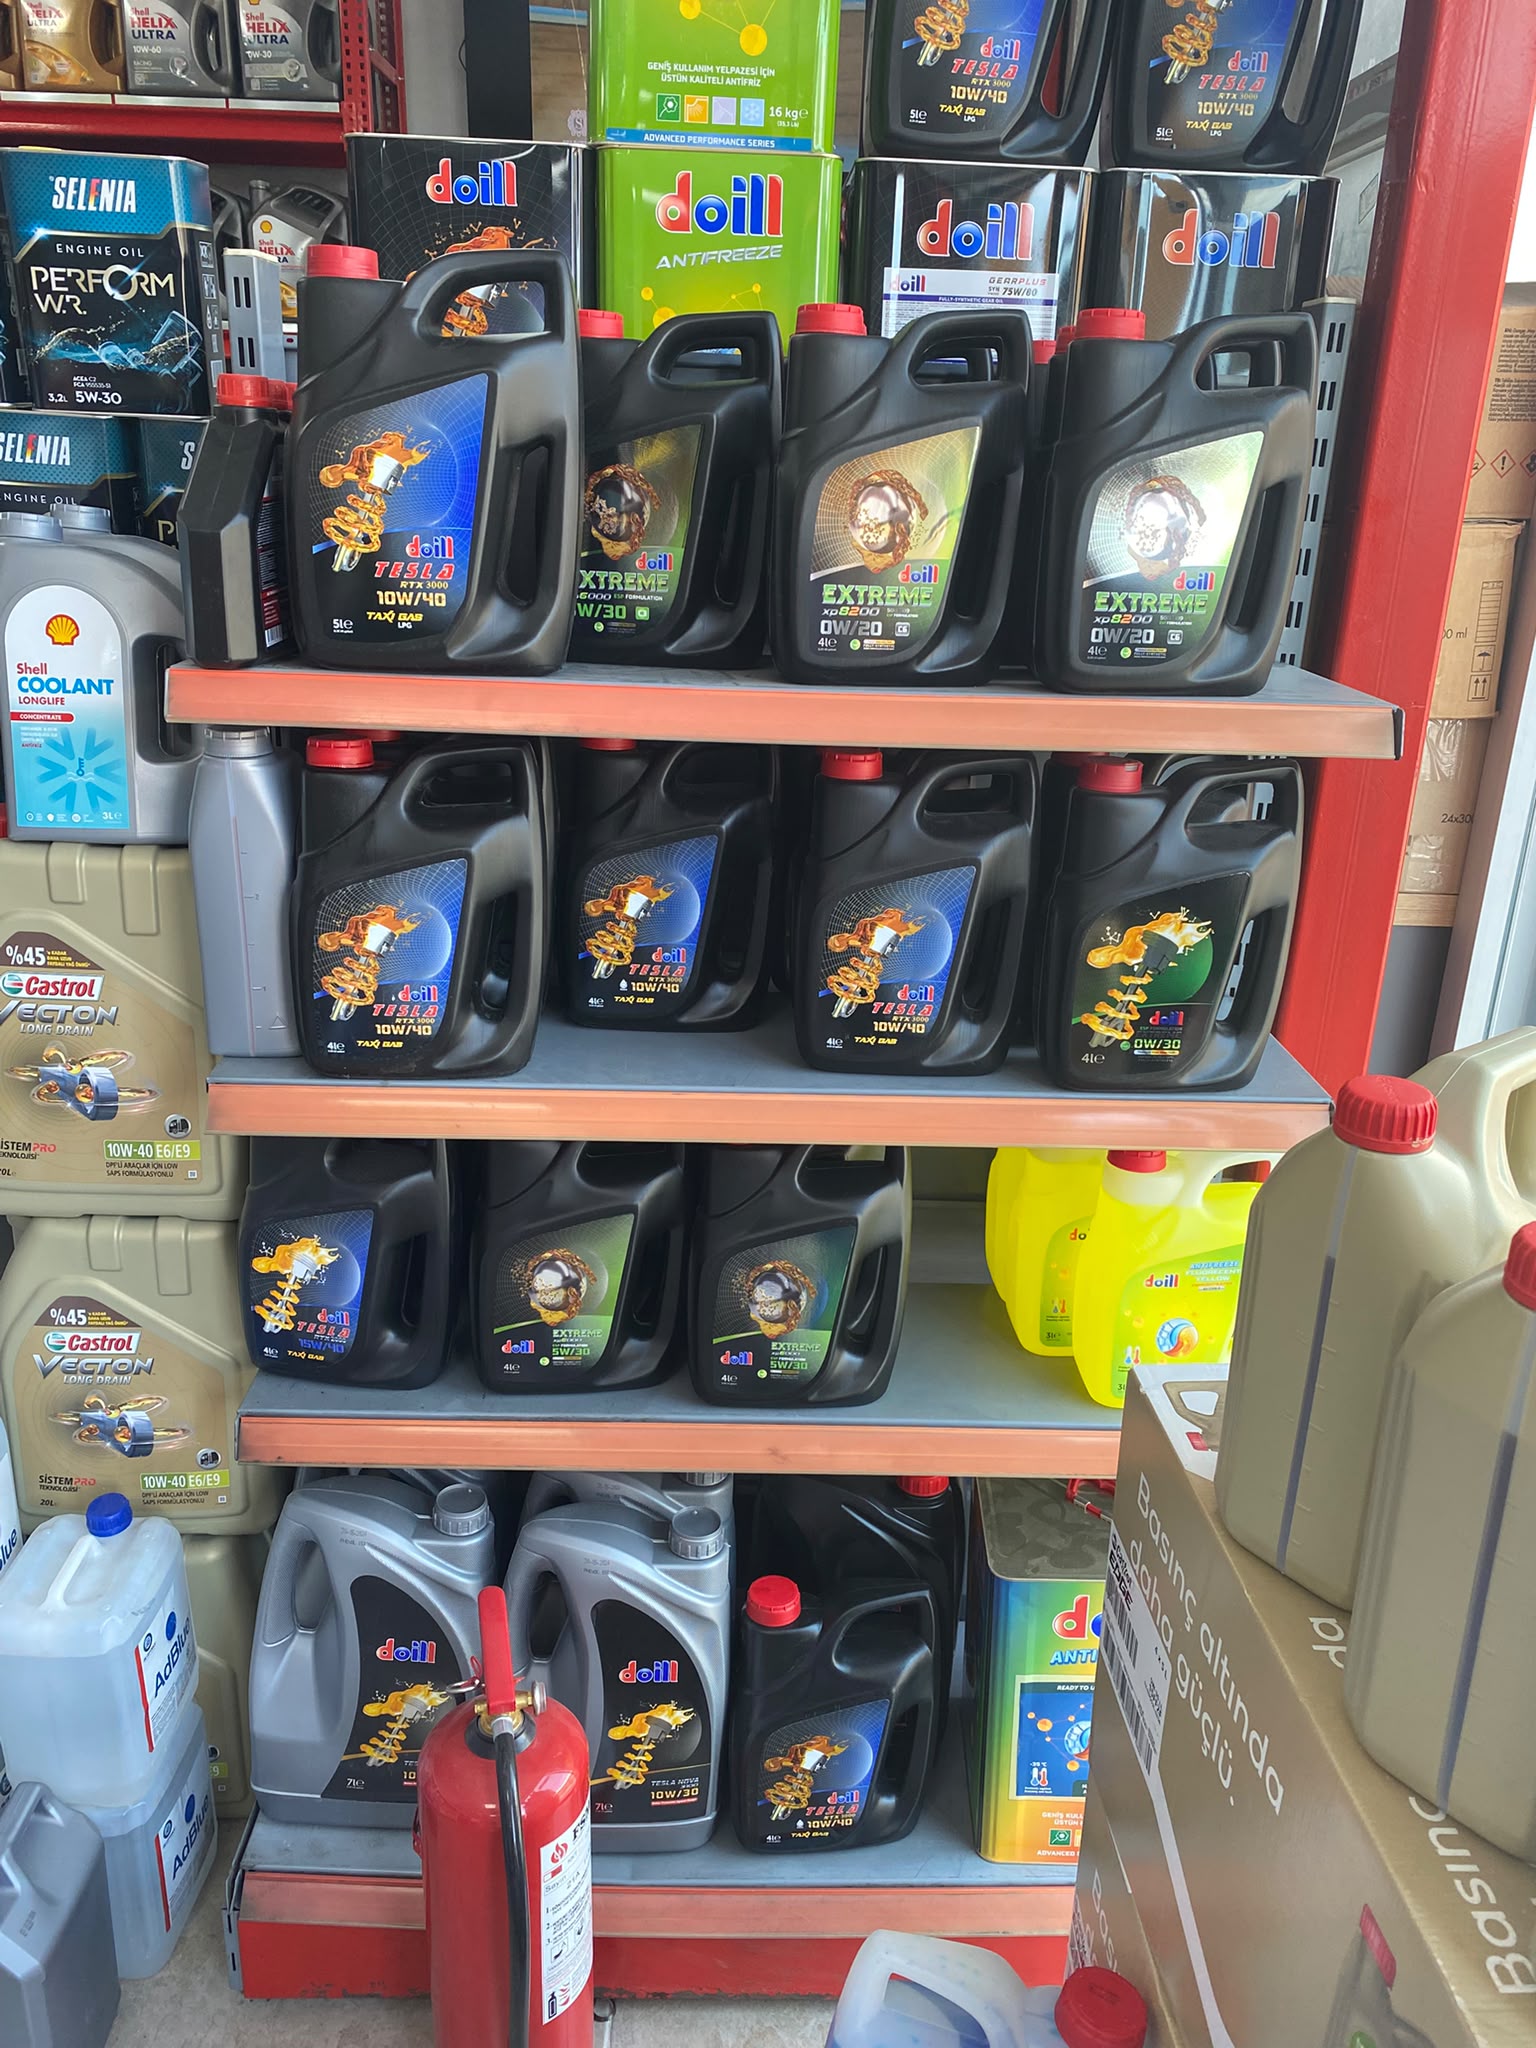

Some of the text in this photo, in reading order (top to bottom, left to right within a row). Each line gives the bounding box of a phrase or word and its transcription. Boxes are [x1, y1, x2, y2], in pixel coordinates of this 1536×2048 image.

[130, 15, 178, 29] HELIX
[245, 13, 265, 21] Shell
[246, 20, 291, 33] HELIX
[131, 30, 176, 40] ULTRA
[245, 34, 289, 44] ULTRA
[132, 45, 162, 54] 10W-60
[980, 36, 1021, 60] doill
[648, 61, 671, 72] GENİŞ
[673, 63, 713, 73] KULLANIM
[715, 65, 758, 75] YELPAZESİ
[951, 58, 1018, 80] TESLA
[1228, 50, 1268, 72] doill
[661, 73, 761, 87] ÜSTÜN KALİTELİ ANTİFRİZ
[1198, 74, 1266, 91] TESLA
[951, 85, 1007, 103] 10W/40
[769, 106, 781, 117] 16
[1198, 102, 1254, 116] 10W/40
[644, 133, 775, 148] ADVANCED PERFORMANCE SERIES
[425, 158, 518, 207] doill
[52, 176, 137, 213] SELENIA
[656, 170, 783, 238] doill
[916, 199, 1035, 261] doill
[1162, 208, 1281, 268] doill
[56, 243, 145, 258] ENGINE OIL
[656, 244, 783, 270] ANTIFREEZE
[30, 264, 175, 301] PERFORM
[989, 276, 1047, 286] GEARPLUS
[33, 294, 87, 315] W.R.
[75, 391, 122, 405] 5W-30
[406, 535, 454, 558] doill
[636, 552, 673, 571] doill
[374, 561, 455, 579] TESLA
[898, 564, 938, 584] doill
[425, 580, 448, 589] 3000
[575, 569, 669, 593] XTREME
[1173, 571, 1215, 591] doill
[376, 590, 446, 607] 10W/40
[822, 584, 934, 608] EXTREME
[1094, 591, 1208, 614] EXTREME
[367, 610, 395, 623] TAXI
[821, 607, 880, 618] xp8200
[1093, 614, 1153, 625] xp8200
[821, 620, 882, 637] 0W/20
[1091, 628, 1155, 644] 0W/20
[1455, 627, 1467, 639] ml
[17, 663, 47, 675] Shell
[17, 677, 114, 695] COOLANT
[18, 696, 65, 706] LONGLIFE
[19, 713, 62, 721] CONCENTRATE
[6, 946, 45, 966] %45
[652, 947, 686, 963] doill
[629, 964, 686, 976] TESLA
[25, 976, 95, 997] Castrol
[398, 985, 438, 1002] doill
[631, 982, 679, 993] 10W/40
[897, 984, 934, 1001] doill
[372, 1004, 438, 1017] TESLA
[872, 1002, 934, 1016] TESLA
[1149, 1010, 1184, 1025] doill
[20, 1024, 94, 1036] LONG DRAIN
[375, 1024, 432, 1035] 10W/40
[873, 1021, 925, 1034] 10W/40
[1134, 1039, 1181, 1049] 0W/30
[107, 1142, 190, 1158] 10W-40 E6/E9
[1144, 1274, 1179, 1288] doill
[50, 1308, 87, 1325] %45
[552, 1329, 602, 1338] EXTREME
[68, 1334, 133, 1351] Castrol
[501, 1340, 590, 1356] doill 5W/30
[771, 1342, 821, 1352] EXTREME
[33, 1354, 154, 1378] VECTON
[720, 1351, 808, 1369] doill 5W/30
[63, 1376, 131, 1385] LONG DRAIN
[143, 1473, 220, 1488] 10W-40 E6/E9
[1130, 1540, 1173, 1653] daha
[376, 1638, 436, 1664] doill
[1135, 1471, 1284, 1815] Basınç altında
[154, 1616, 190, 1698] AdBlue
[619, 1660, 678, 1683] doill
[651, 1787, 699, 1799] 10W/30
[827, 1790, 859, 1804] doill
[805, 1804, 859, 1816] TESLA
[807, 1818, 853, 1828] 10W/40
